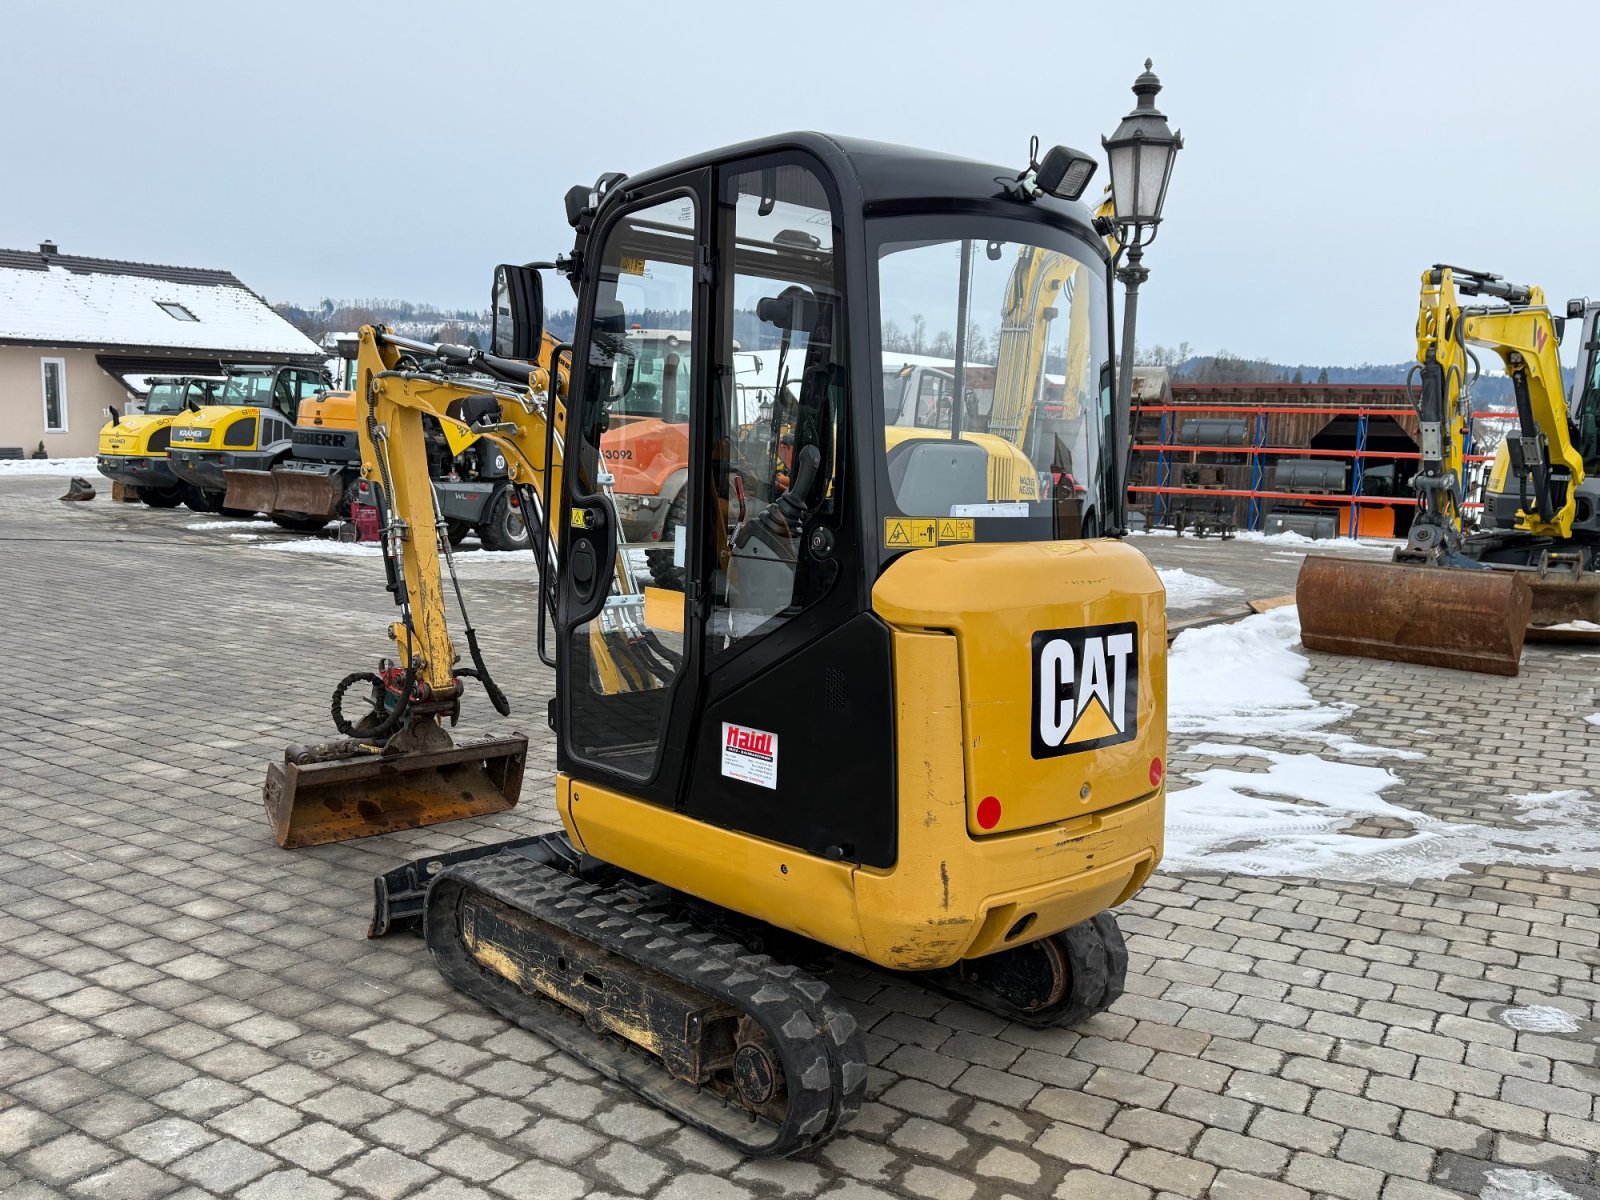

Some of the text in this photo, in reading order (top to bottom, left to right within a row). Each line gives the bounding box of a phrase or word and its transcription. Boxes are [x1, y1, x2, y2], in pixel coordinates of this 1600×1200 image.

[179, 429, 202, 437] KRAMER
[1040, 633, 1133, 747] CAT
[726, 725, 773, 756] Haidl
